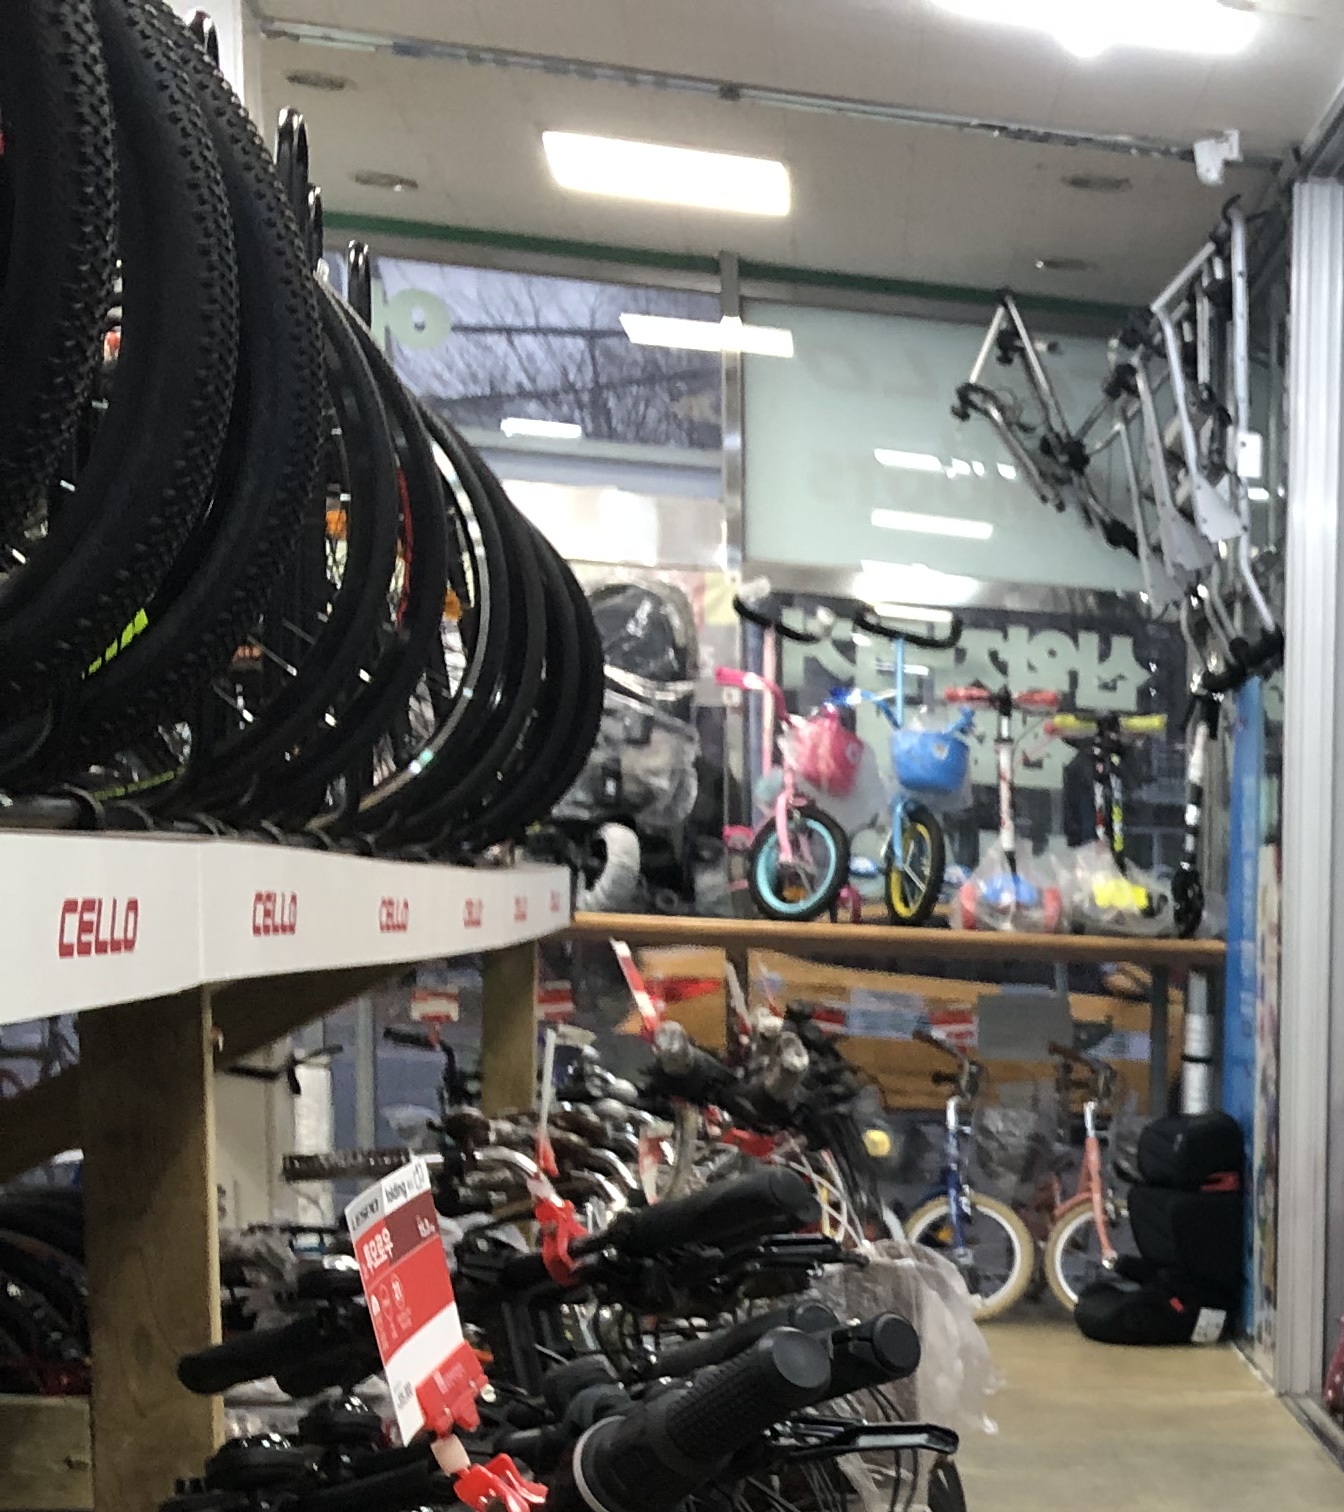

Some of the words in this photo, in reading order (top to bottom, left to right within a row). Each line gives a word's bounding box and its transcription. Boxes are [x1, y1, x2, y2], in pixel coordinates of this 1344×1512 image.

[58, 898, 139, 958] CELLO
[252, 891, 297, 936] CELLO
[379, 896, 409, 932] CELLO
